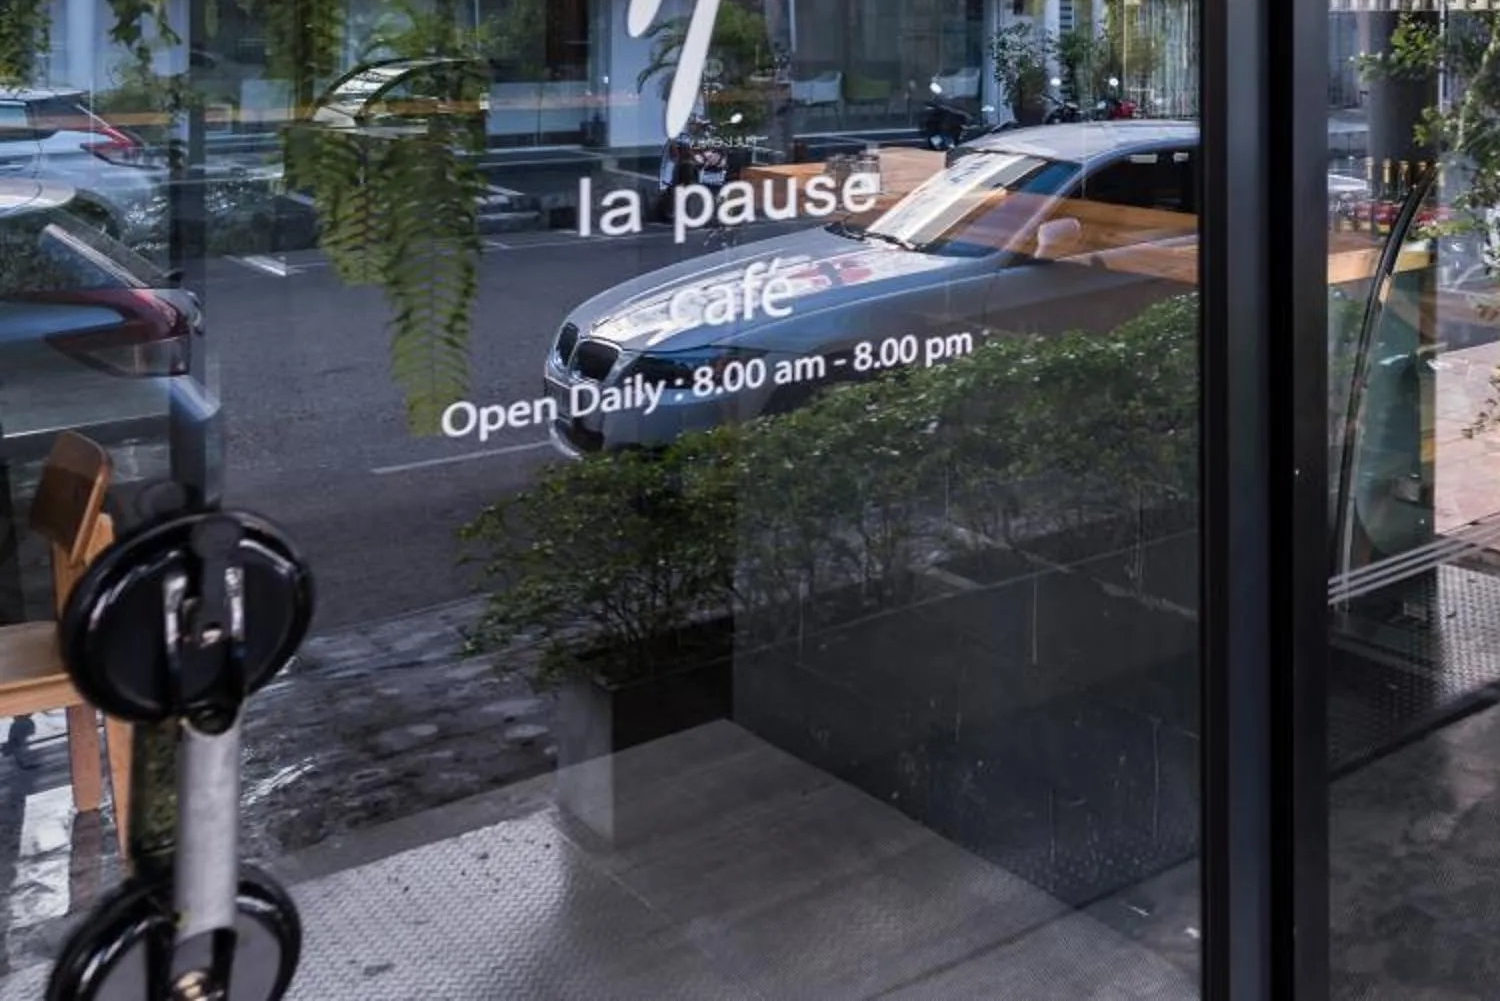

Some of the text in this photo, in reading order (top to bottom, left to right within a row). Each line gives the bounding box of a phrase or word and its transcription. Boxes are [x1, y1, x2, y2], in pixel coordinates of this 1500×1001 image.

[577, 169, 881, 244] la pause
[668, 255, 795, 329] café
[441, 395, 558, 441] Open
[569, 371, 667, 416] Daily
[692, 358, 767, 399] 8.00
[773, 354, 826, 385] am
[853, 334, 918, 372] 8.00
[924, 330, 974, 368] pm
